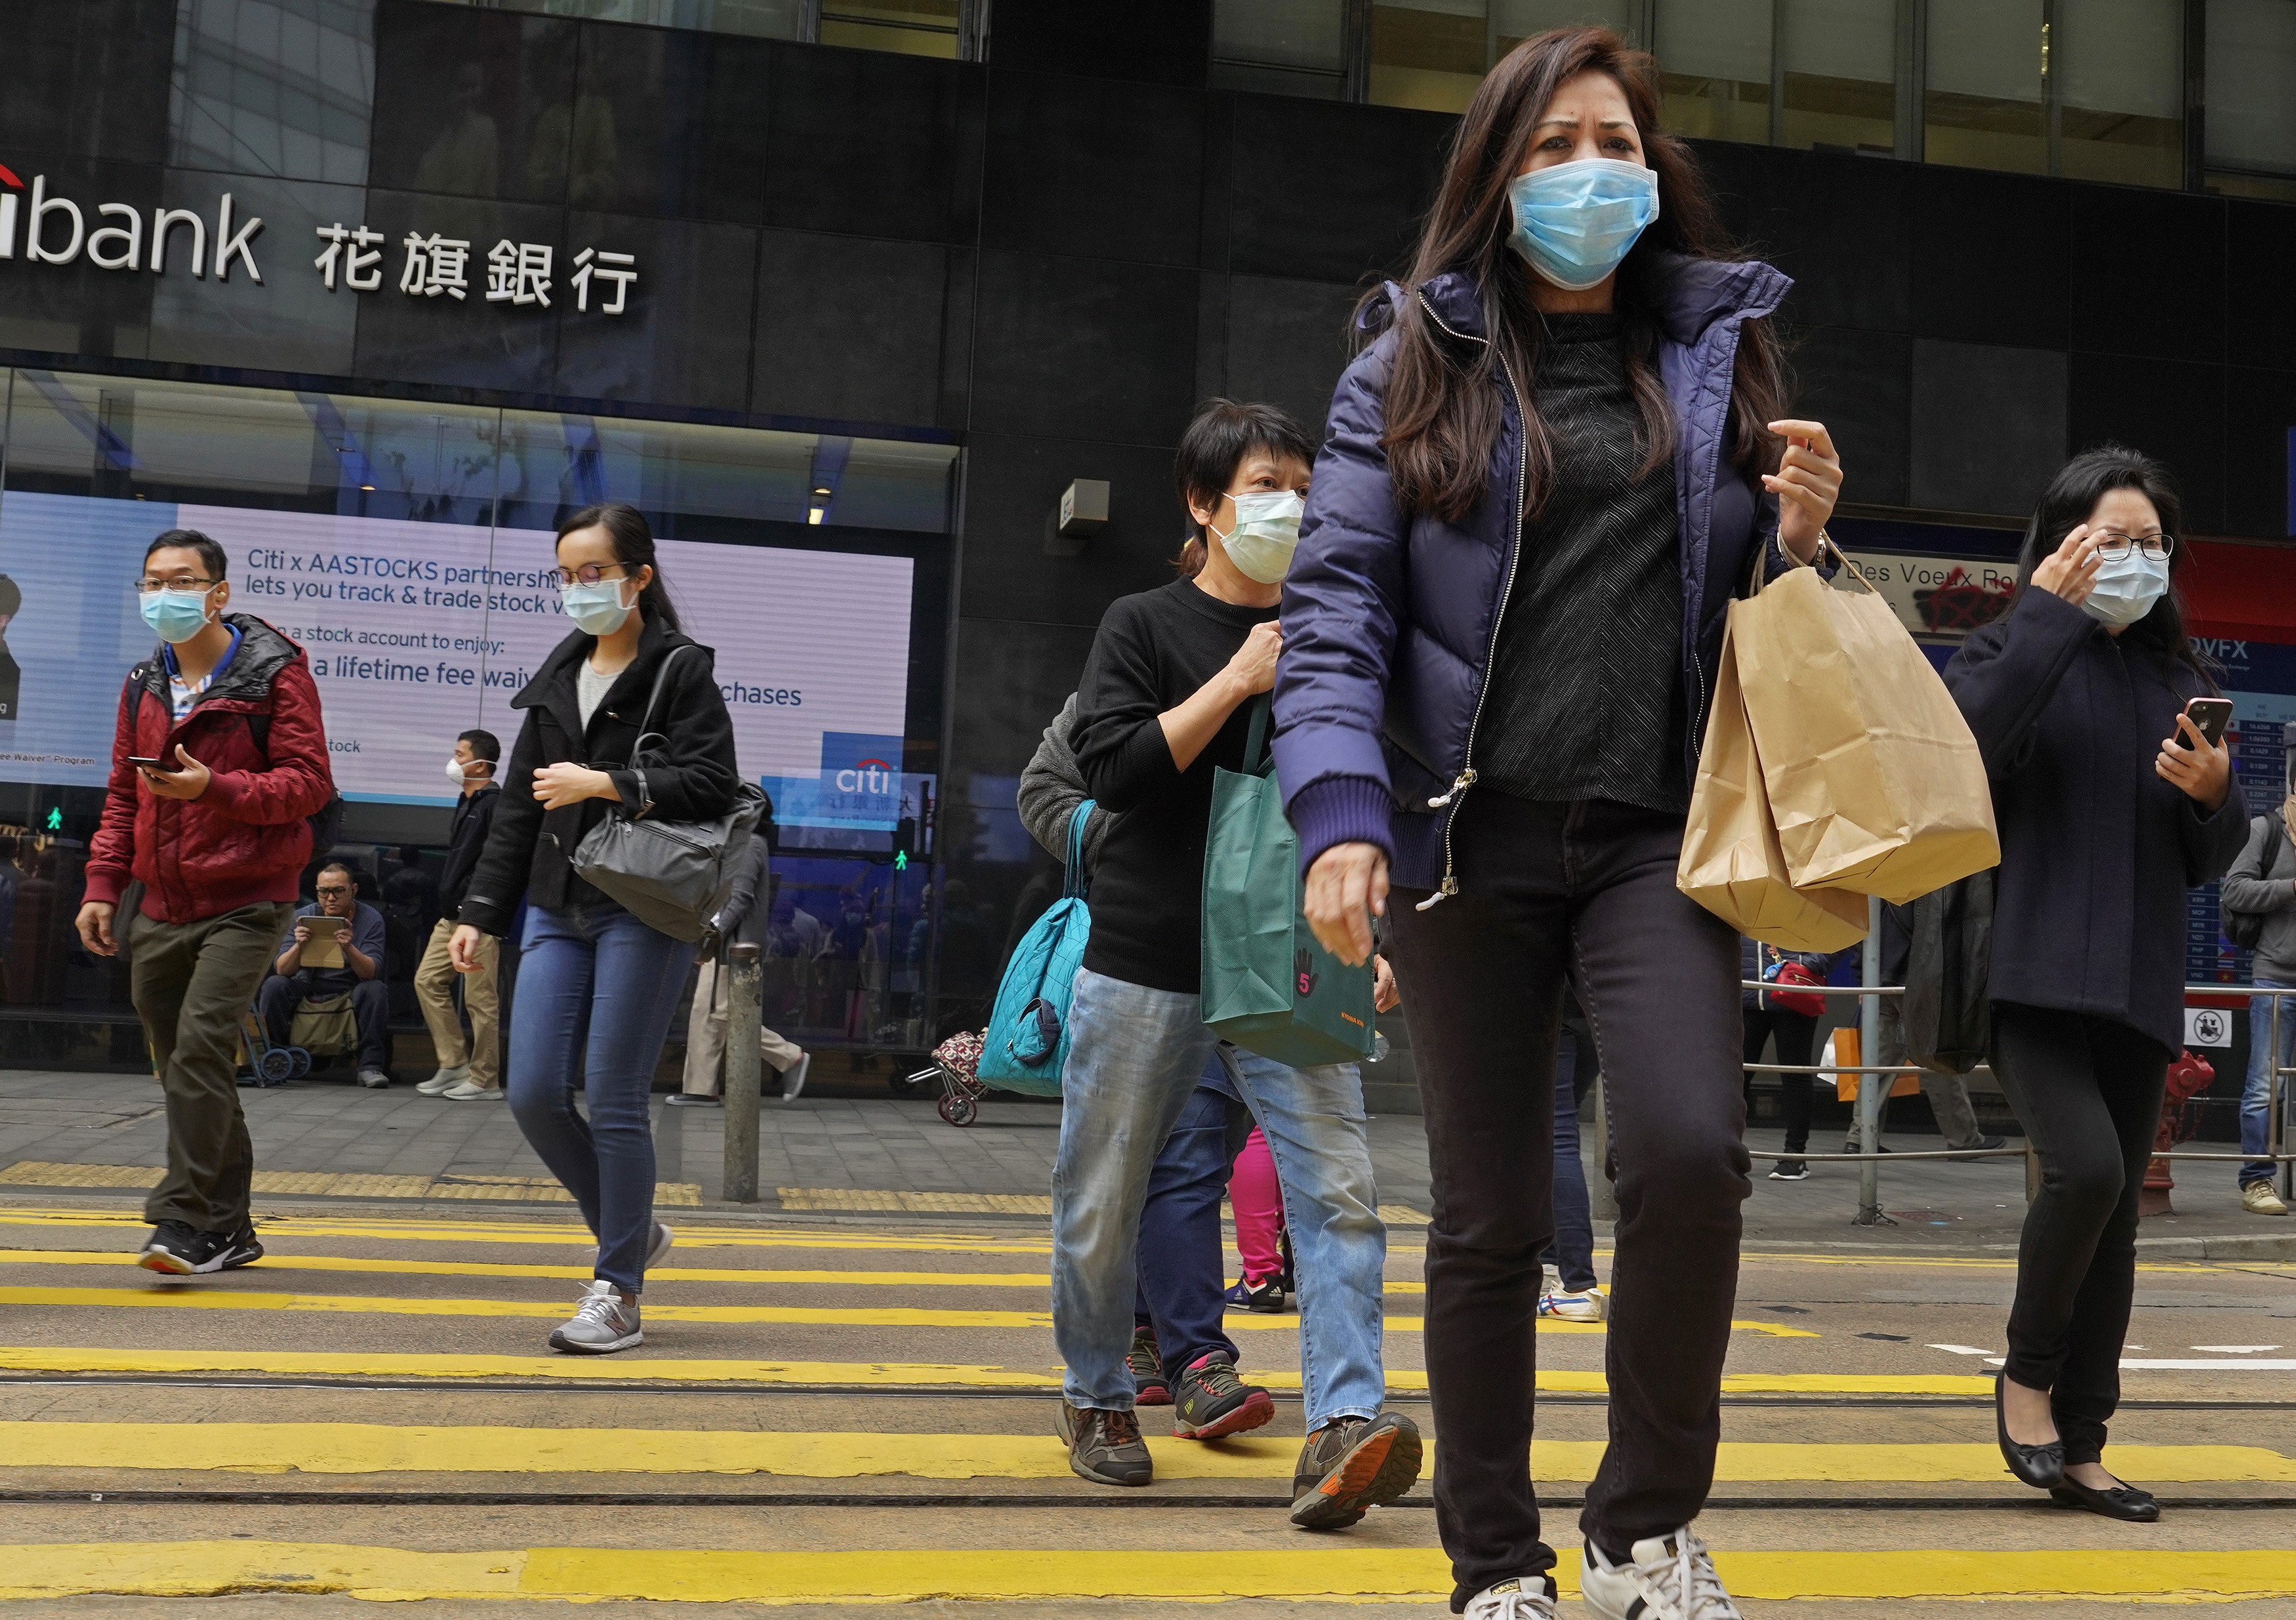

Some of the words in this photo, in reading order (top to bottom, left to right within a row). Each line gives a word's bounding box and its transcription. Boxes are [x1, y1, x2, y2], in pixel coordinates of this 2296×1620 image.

[0, 174, 265, 283] ibank
[314, 222, 638, 315] 花旗銀行
[248, 549, 285, 571] Citi
[291, 556, 302, 571] x
[309, 554, 438, 580] AASTOCKS
[1847, 559, 1890, 581] Des
[1900, 563, 1973, 587] Voeux
[1983, 569, 2013, 590] Ro
[246, 574, 285, 595] lets
[293, 581, 331, 601] you
[338, 580, 395, 603] track
[401, 586, 417, 605] &
[424, 587, 482, 609] trade
[487, 593, 545, 614] stock
[293, 628, 301, 639] a
[306, 626, 353, 642] stock
[358, 631, 427, 649] account
[432, 633, 450, 649] to
[455, 638, 505, 656] enjoy:
[314, 659, 327, 676] a
[337, 656, 430, 683] lifetime
[437, 662, 475, 685] fee
[719, 681, 802, 706] chases
[53, 755, 95, 766] Program
[329, 739, 361, 753] tock
[1300, 973, 1309, 993] 5
